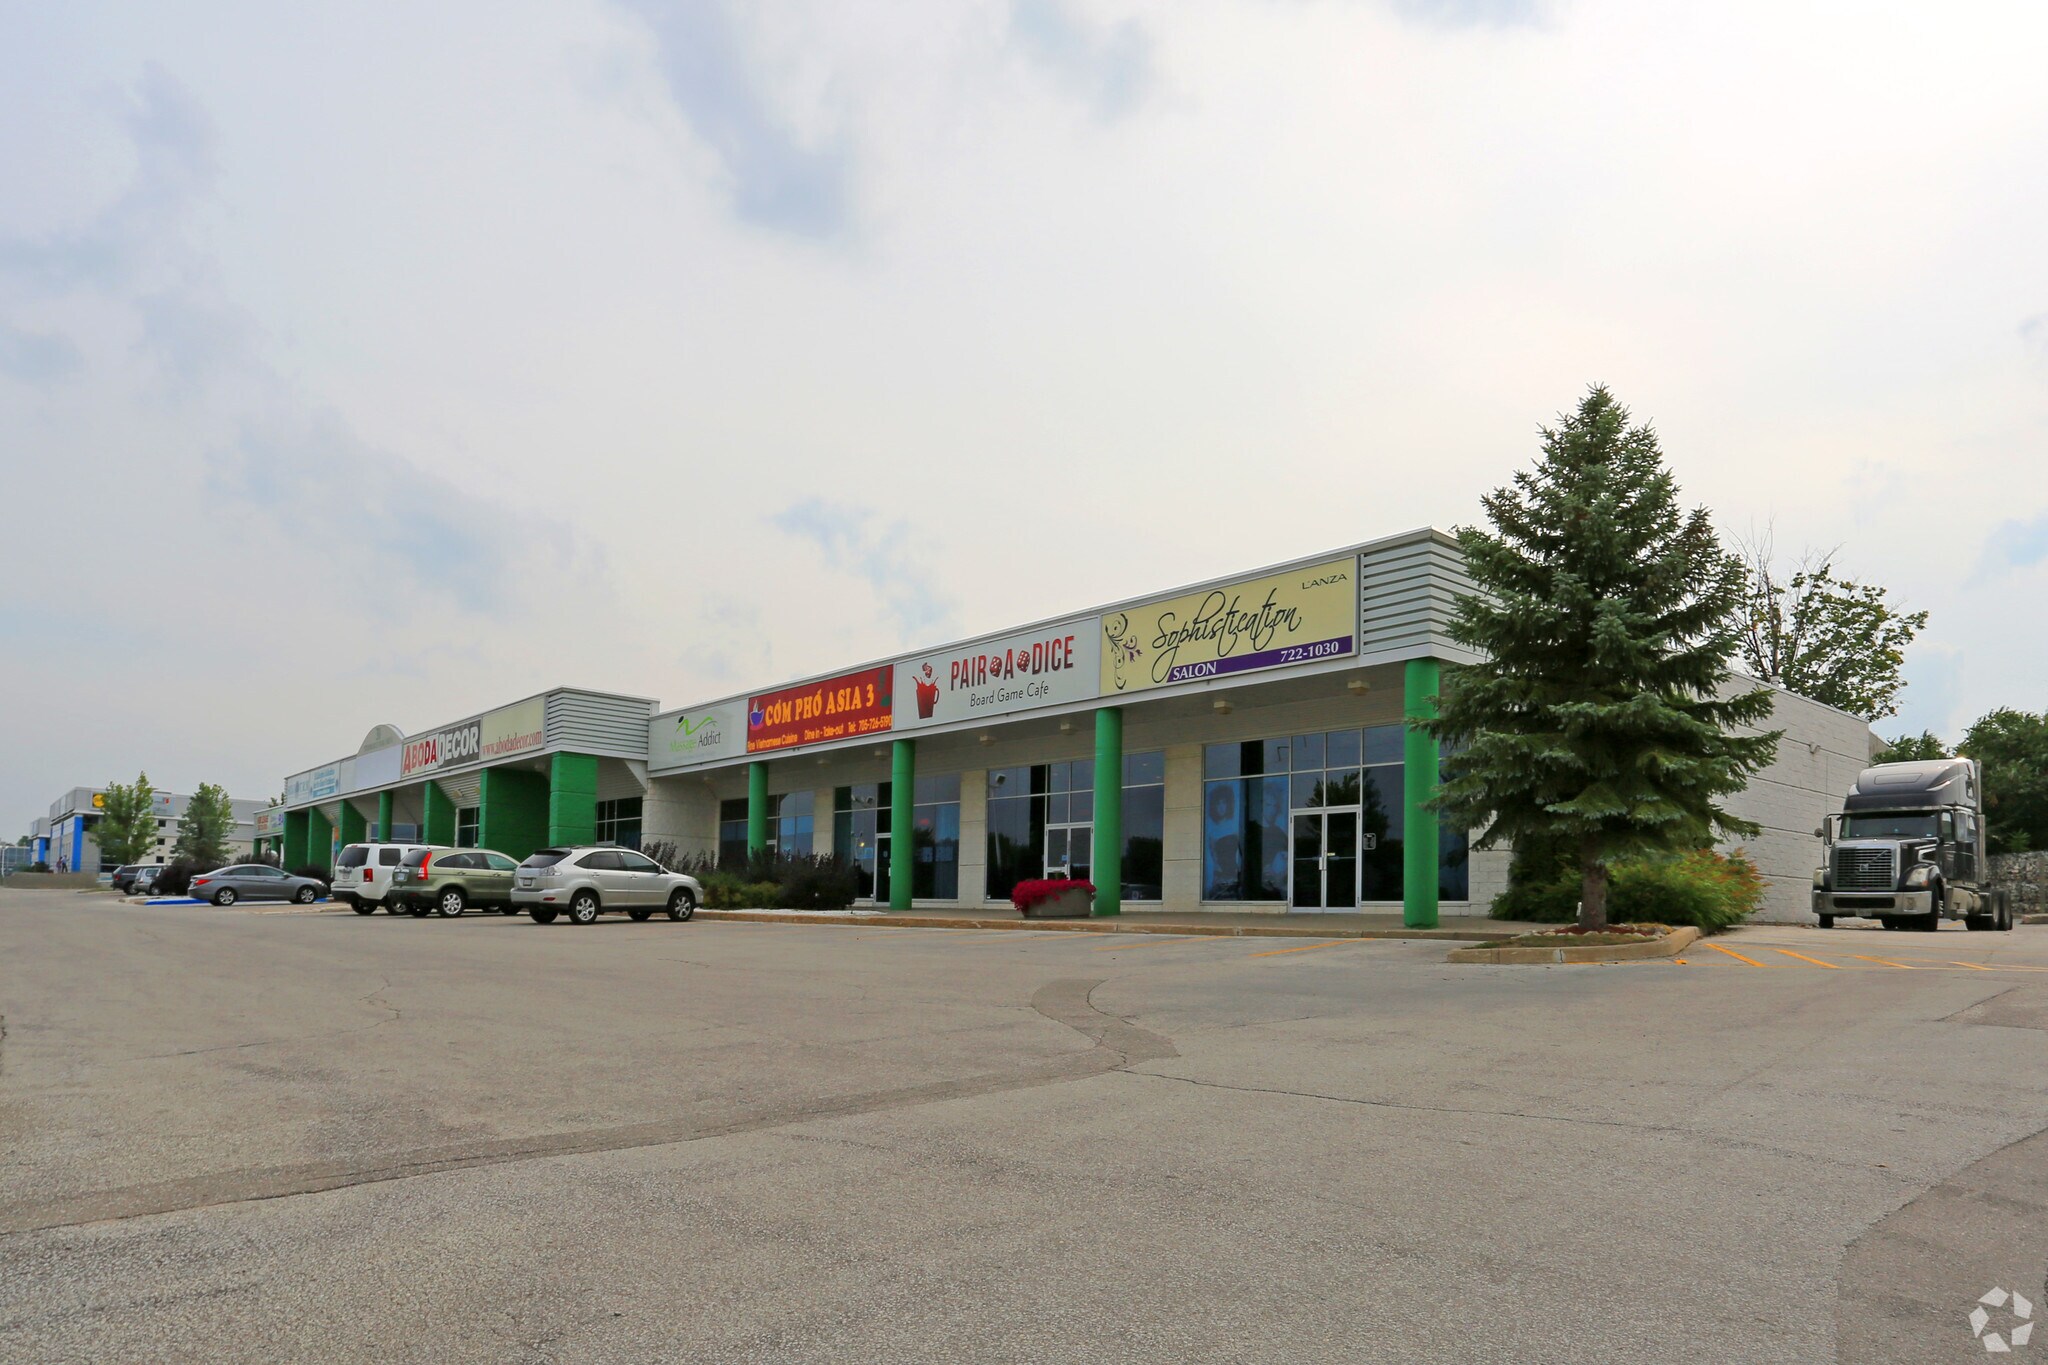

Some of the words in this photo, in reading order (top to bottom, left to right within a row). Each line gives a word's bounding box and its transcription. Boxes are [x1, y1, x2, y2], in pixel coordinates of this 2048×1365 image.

[1151, 587, 1302, 684] Sophistication
[950, 655, 986, 691] PAIR
[1003, 648, 1014, 680] A
[1032, 635, 1075, 675] DICE
[1280, 641, 1339, 663] 722-1030
[1172, 661, 1217, 681] SALON
[825, 686, 862, 715] ASIA
[866, 683, 875, 707] 3
[970, 690, 994, 707] Board
[997, 686, 1024, 702] Game
[698, 731, 721, 749] Addict
